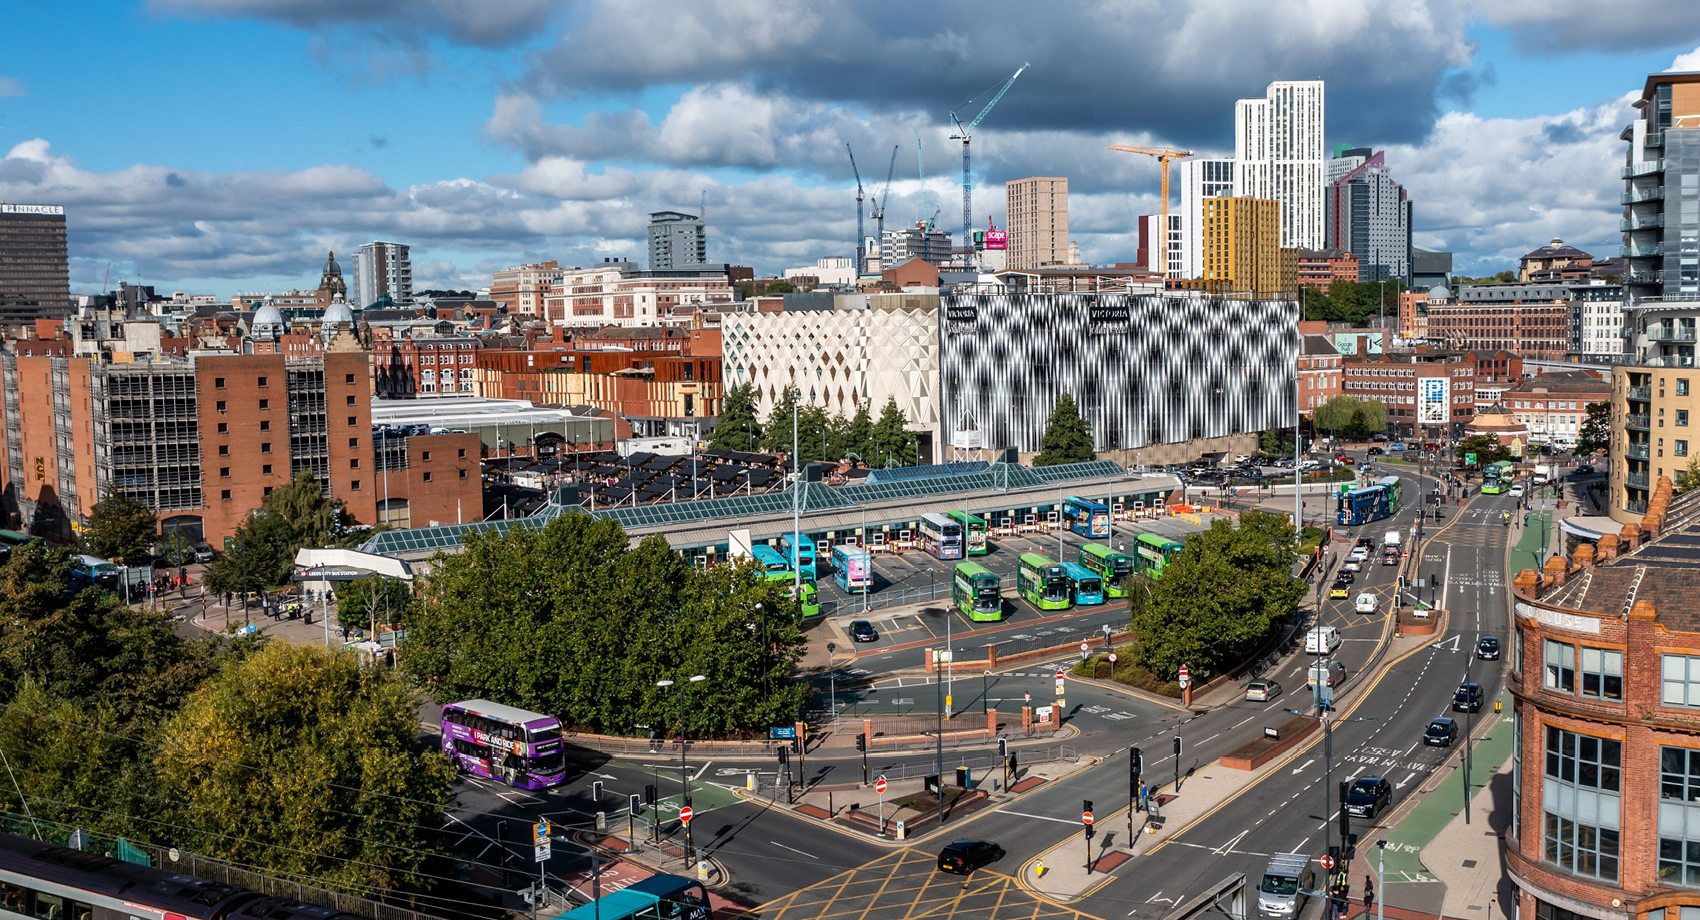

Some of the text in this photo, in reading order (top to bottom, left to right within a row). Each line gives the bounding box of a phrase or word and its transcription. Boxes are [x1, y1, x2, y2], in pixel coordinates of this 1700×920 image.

[7, 205, 60, 214] PINNACLE
[988, 232, 1005, 241] scape
[948, 310, 974, 318] VICTORIA
[1092, 310, 1128, 318] VICTORIA
[35, 456, 44, 480] NCP
[1538, 610, 1583, 629] HOUSE
[477, 732, 490, 742] PARK
[491, 736, 502, 745] AND
[502, 739, 514, 750] RIDE
[690, 906, 706, 919] MAX
